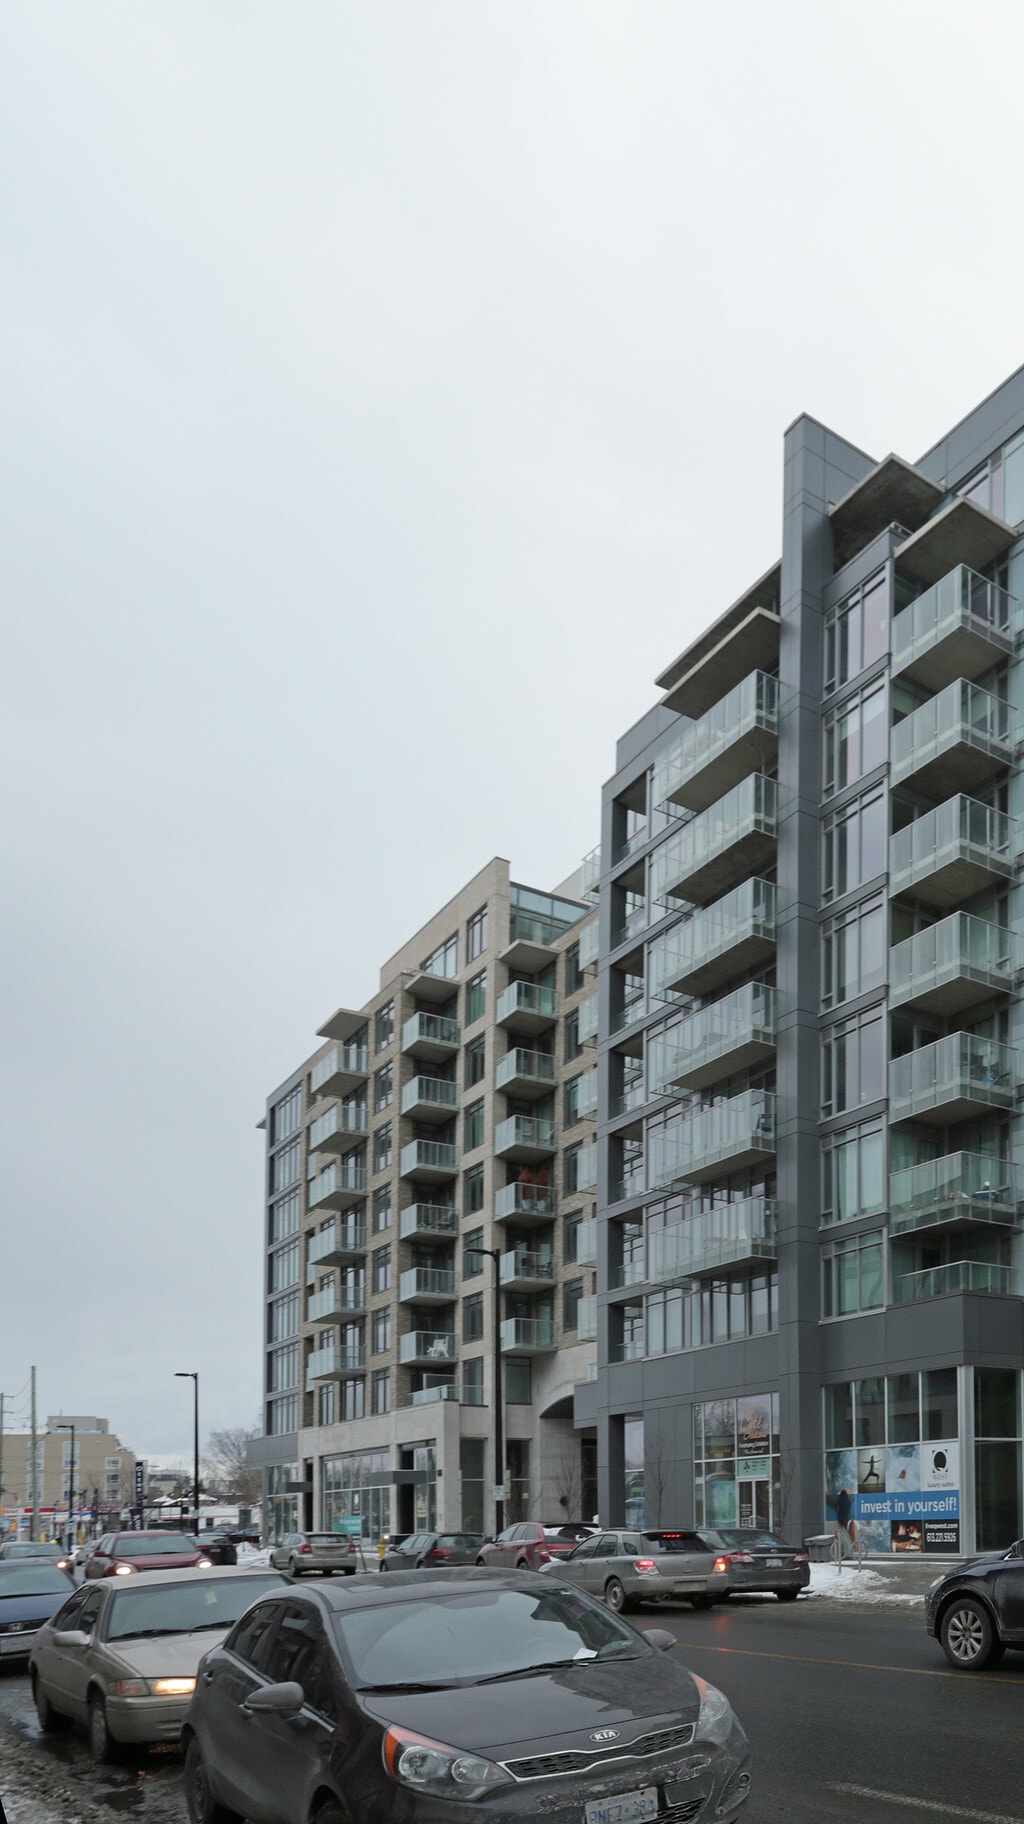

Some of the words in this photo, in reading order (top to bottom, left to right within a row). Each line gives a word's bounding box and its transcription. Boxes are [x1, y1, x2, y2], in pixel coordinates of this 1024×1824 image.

[861, 1500, 892, 1514] invest
[894, 1499, 905, 1513] in
[907, 1497, 957, 1515] yourself!
[593, 1731, 616, 1741] KIA
